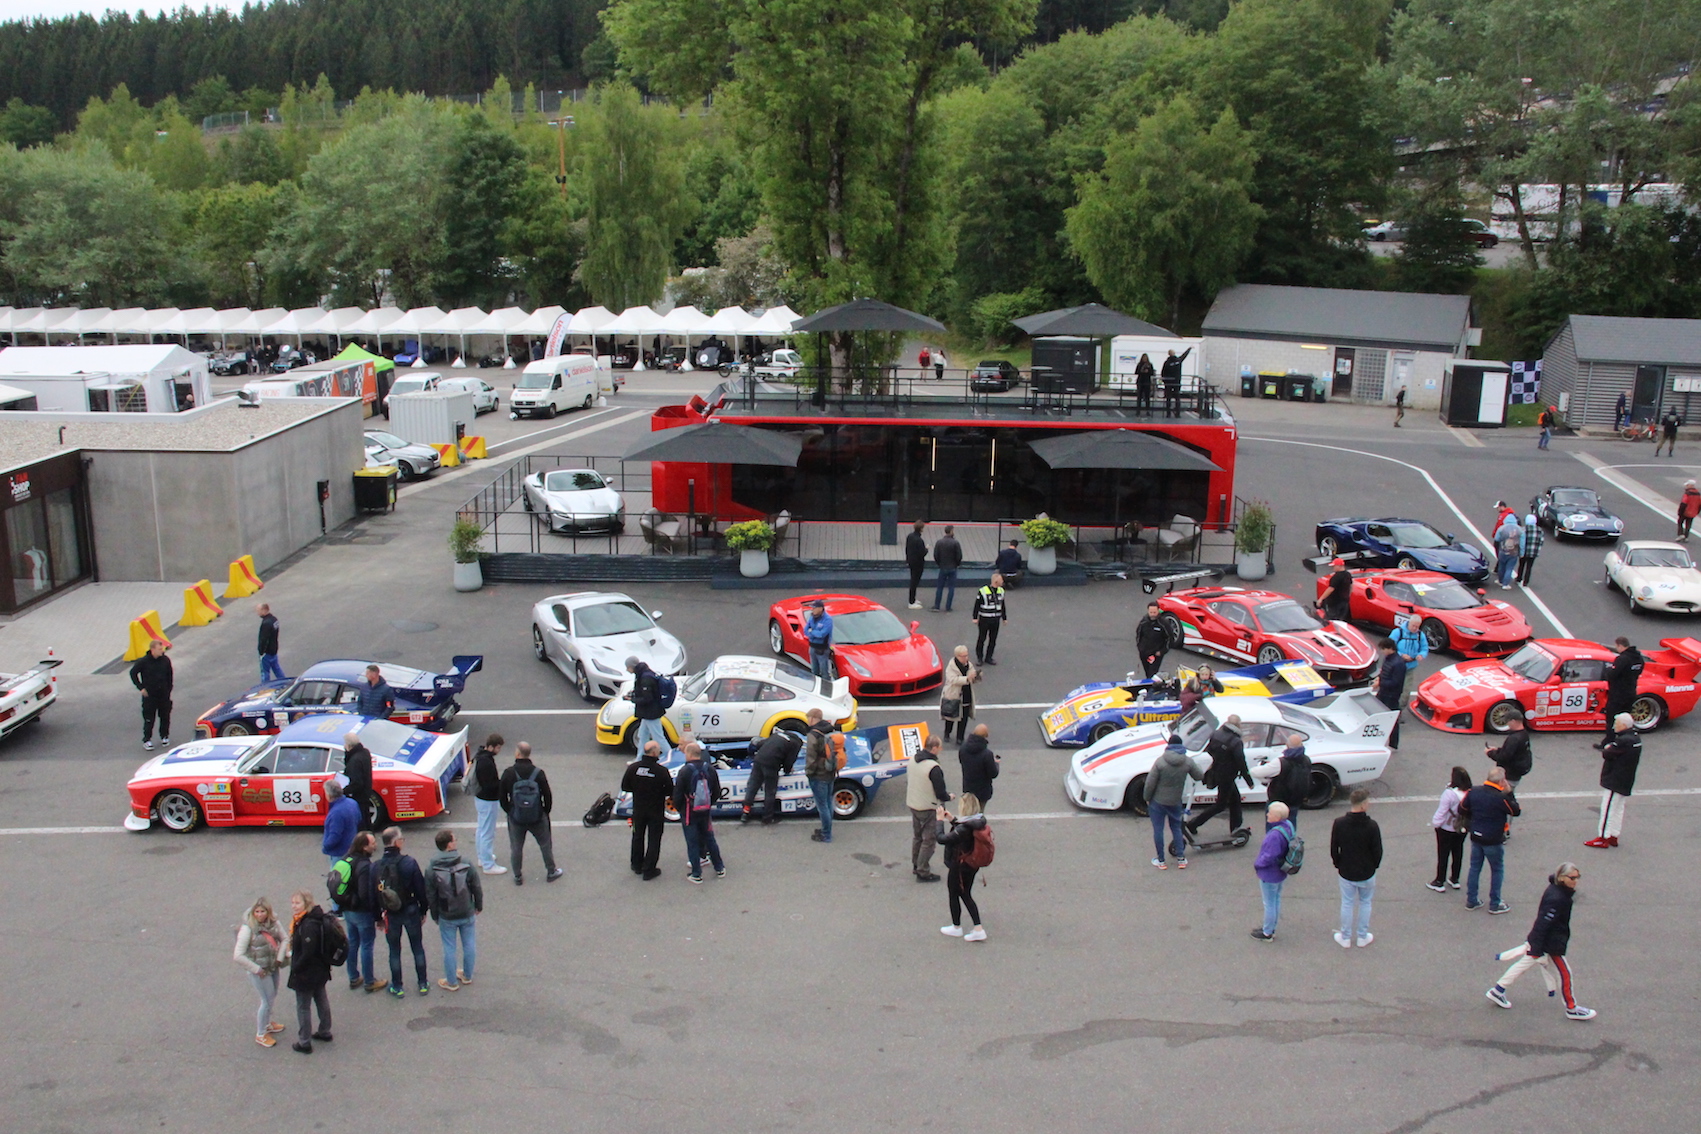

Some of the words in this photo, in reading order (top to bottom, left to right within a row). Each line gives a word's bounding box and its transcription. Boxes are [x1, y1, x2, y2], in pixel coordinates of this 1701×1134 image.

[572, 365, 593, 375] danielson
[1236, 638, 1252, 653] 21
[1665, 684, 1695, 693] Manns
[1565, 694, 1583, 707] 58
[411, 712, 422, 721] GT2
[701, 714, 720, 726] 76
[1139, 713, 1181, 723] Ultram
[281, 790, 302, 804] 83
